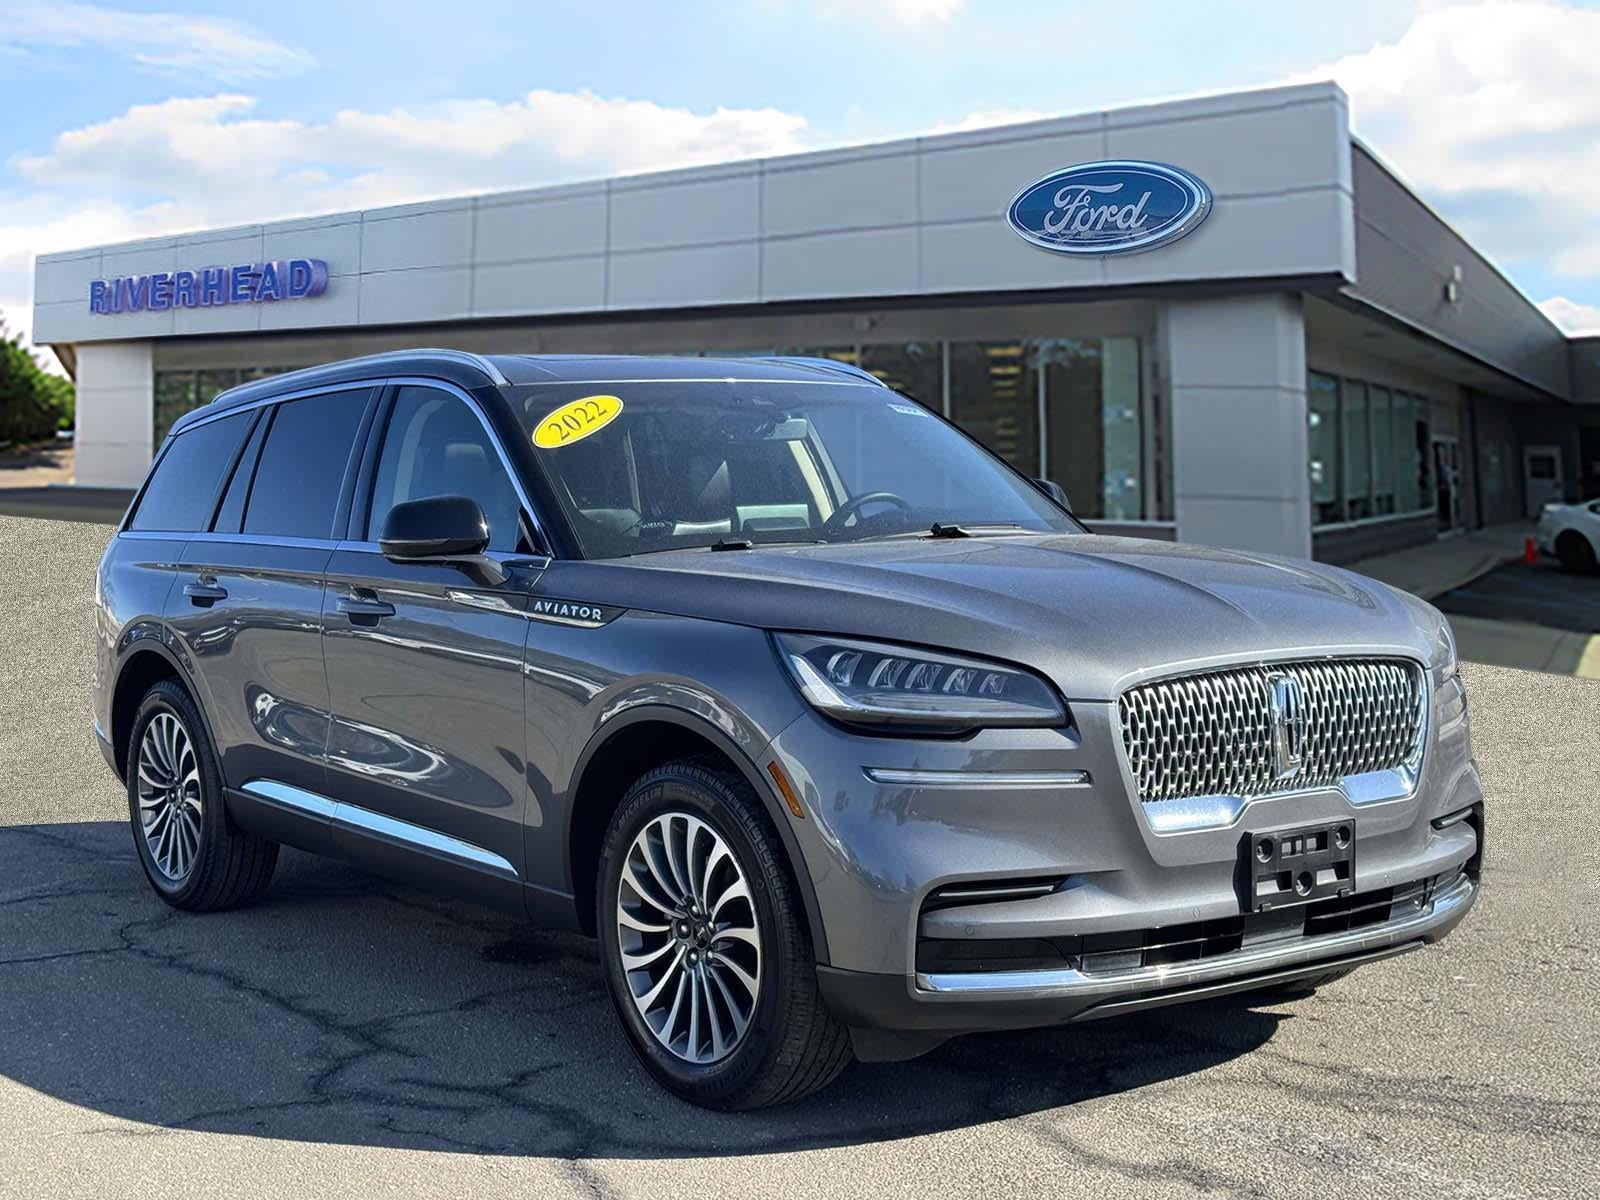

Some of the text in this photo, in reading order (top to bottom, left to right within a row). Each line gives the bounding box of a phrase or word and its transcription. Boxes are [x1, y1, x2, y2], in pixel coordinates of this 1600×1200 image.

[1043, 183, 1152, 234] Ford
[89, 258, 316, 314] RIVERHEAD
[548, 400, 607, 440] 2022
[534, 600, 602, 620] AVIATOR
